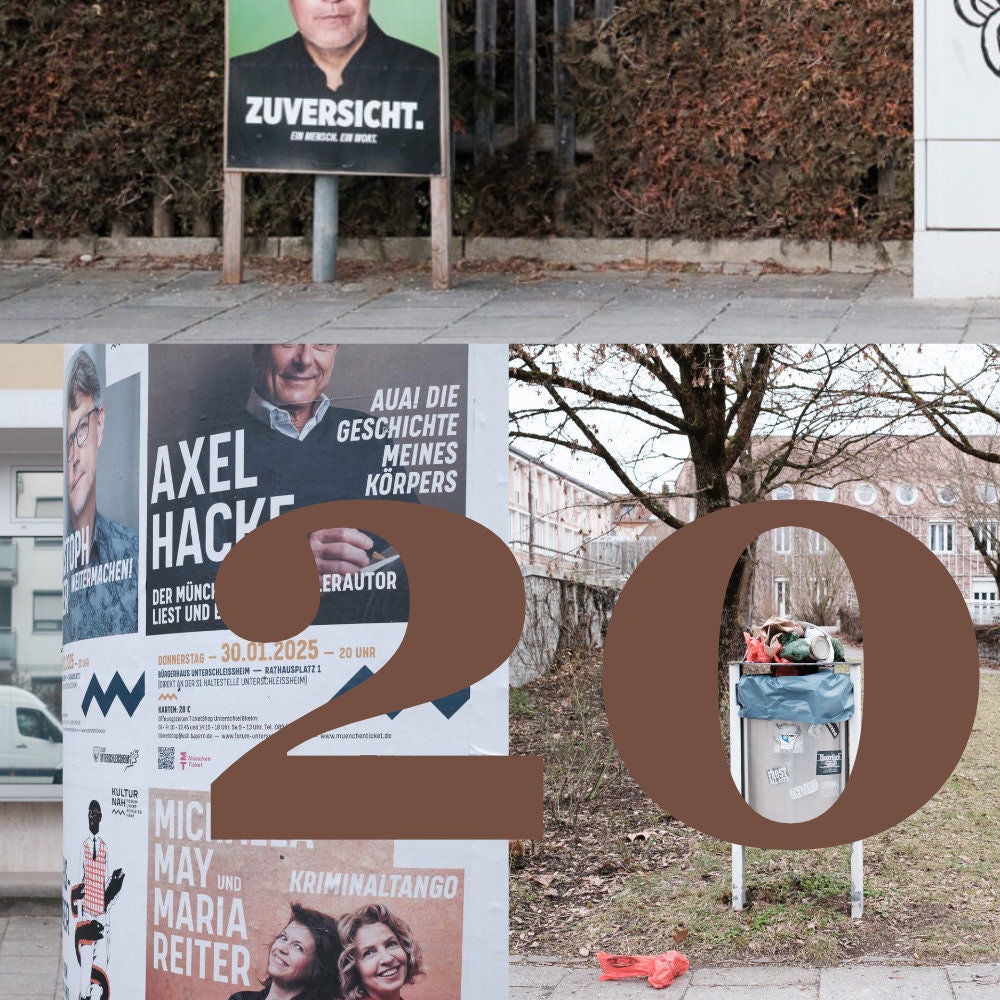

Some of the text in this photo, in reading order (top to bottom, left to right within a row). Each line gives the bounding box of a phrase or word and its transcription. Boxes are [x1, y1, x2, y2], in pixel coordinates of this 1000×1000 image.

[245, 96, 424, 130] ZUVERSICHT.
[290, 131, 377, 144] EIN MENSCH. EIN WORT.
[370, 384, 460, 412] AUA! DIE
[336, 413, 460, 442] GESCHICHTE
[151, 429, 258, 504] AXEL
[382, 441, 459, 467] MEINES
[365, 468, 458, 496] KÖRPERS
[71, 557, 133, 593] WEITERMACHEN!
[152, 588, 172, 605] DER
[152, 606, 181, 625] LIEST
[185, 603, 209, 622] UND
[158, 639, 376, 665] DONNERSTAG 30.01.2025 20 UHR
[158, 665, 322, 678] BÜRGERHAUS UNTERSCHLEISSHEIM RATHAUSPLATZ 1
[185, 680, 195, 688] DER
[203, 678, 240, 687] HALTESTELLE
[241, 676, 308, 686] UNTERSCHLEISSHEIM)
[111, 788, 139, 799] KULTUR
[111, 798, 126, 807] NAH
[154, 843, 242, 892] MAY UND
[288, 869, 459, 899] KRIMINALTANGO
[153, 887, 248, 940] MARIA
[153, 931, 251, 986] REITER
